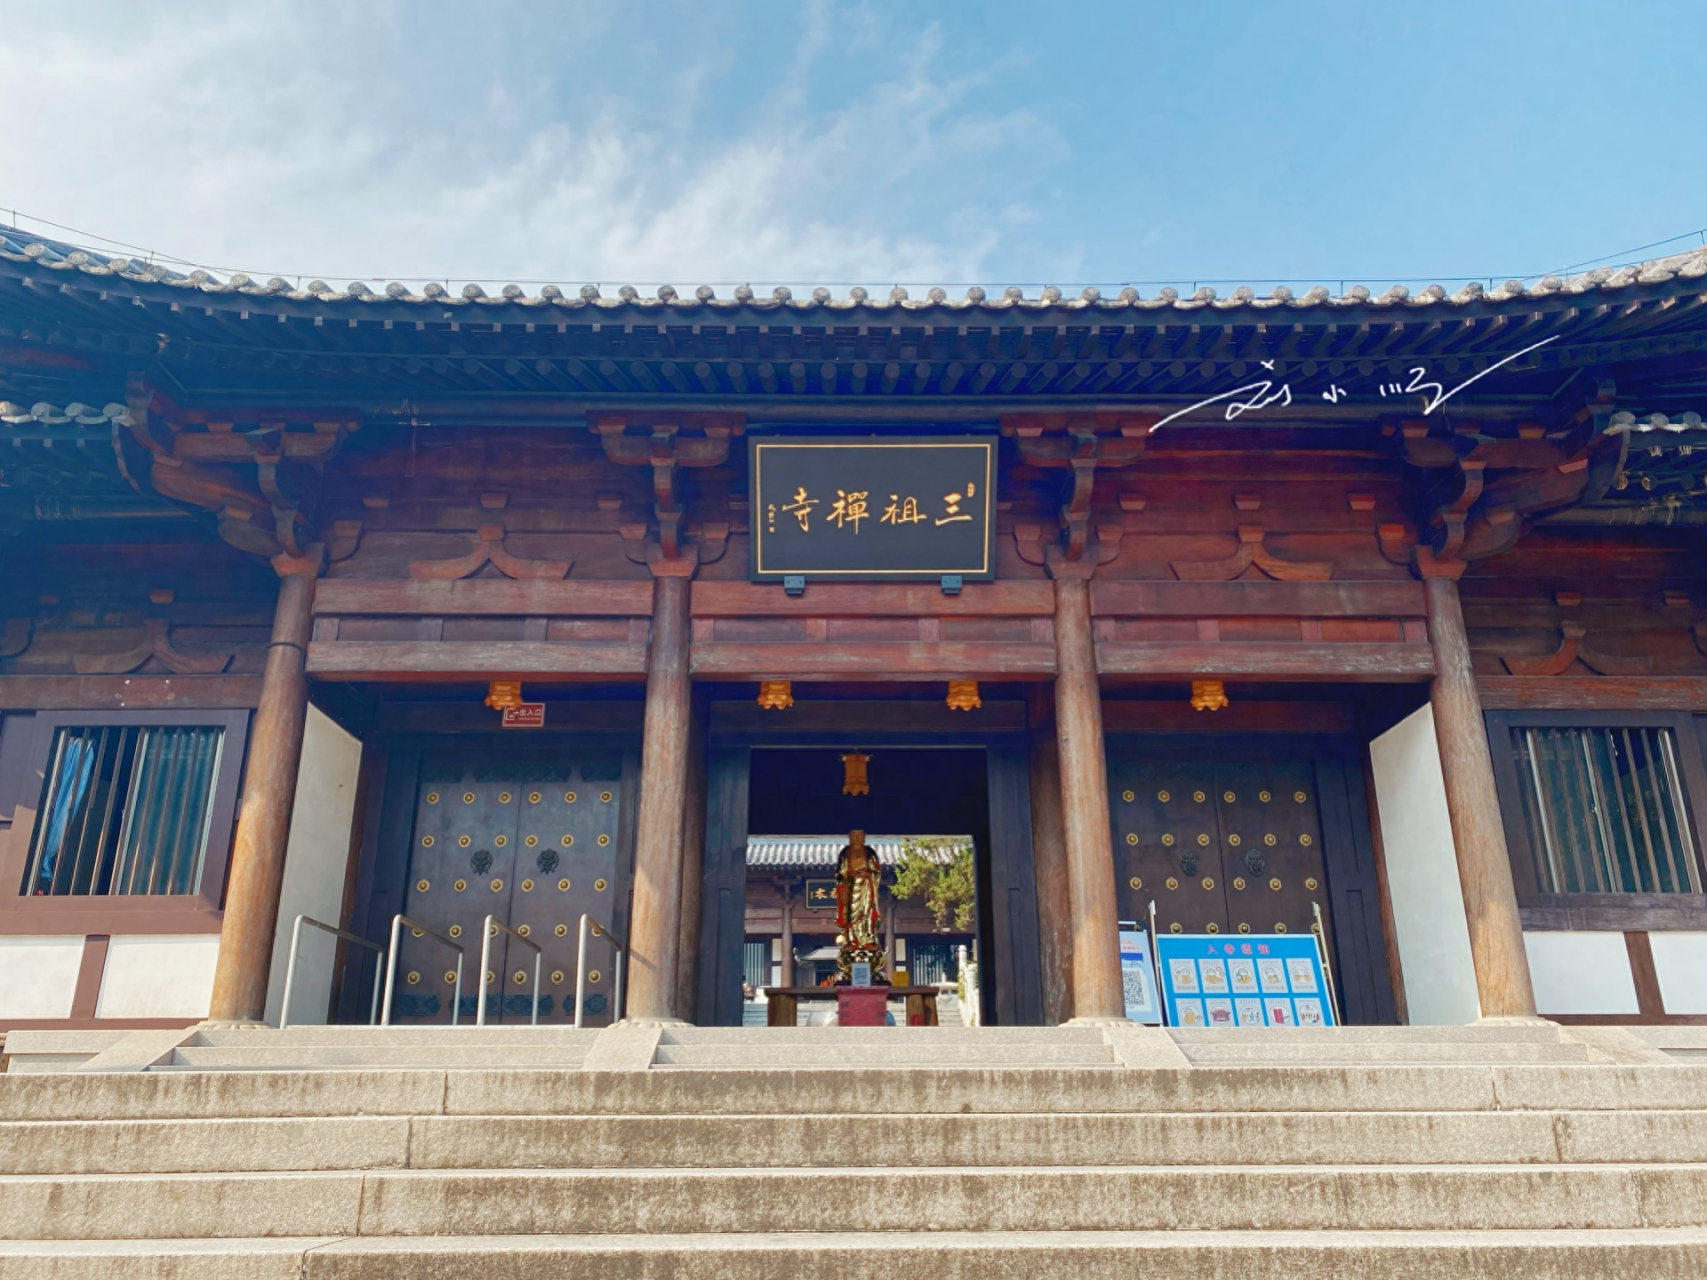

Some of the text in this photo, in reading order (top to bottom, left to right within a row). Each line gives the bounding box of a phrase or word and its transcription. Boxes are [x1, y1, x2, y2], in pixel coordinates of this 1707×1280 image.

[519, 708, 542, 717] 出入口
[1207, 943, 1271, 955] 入寺须知
